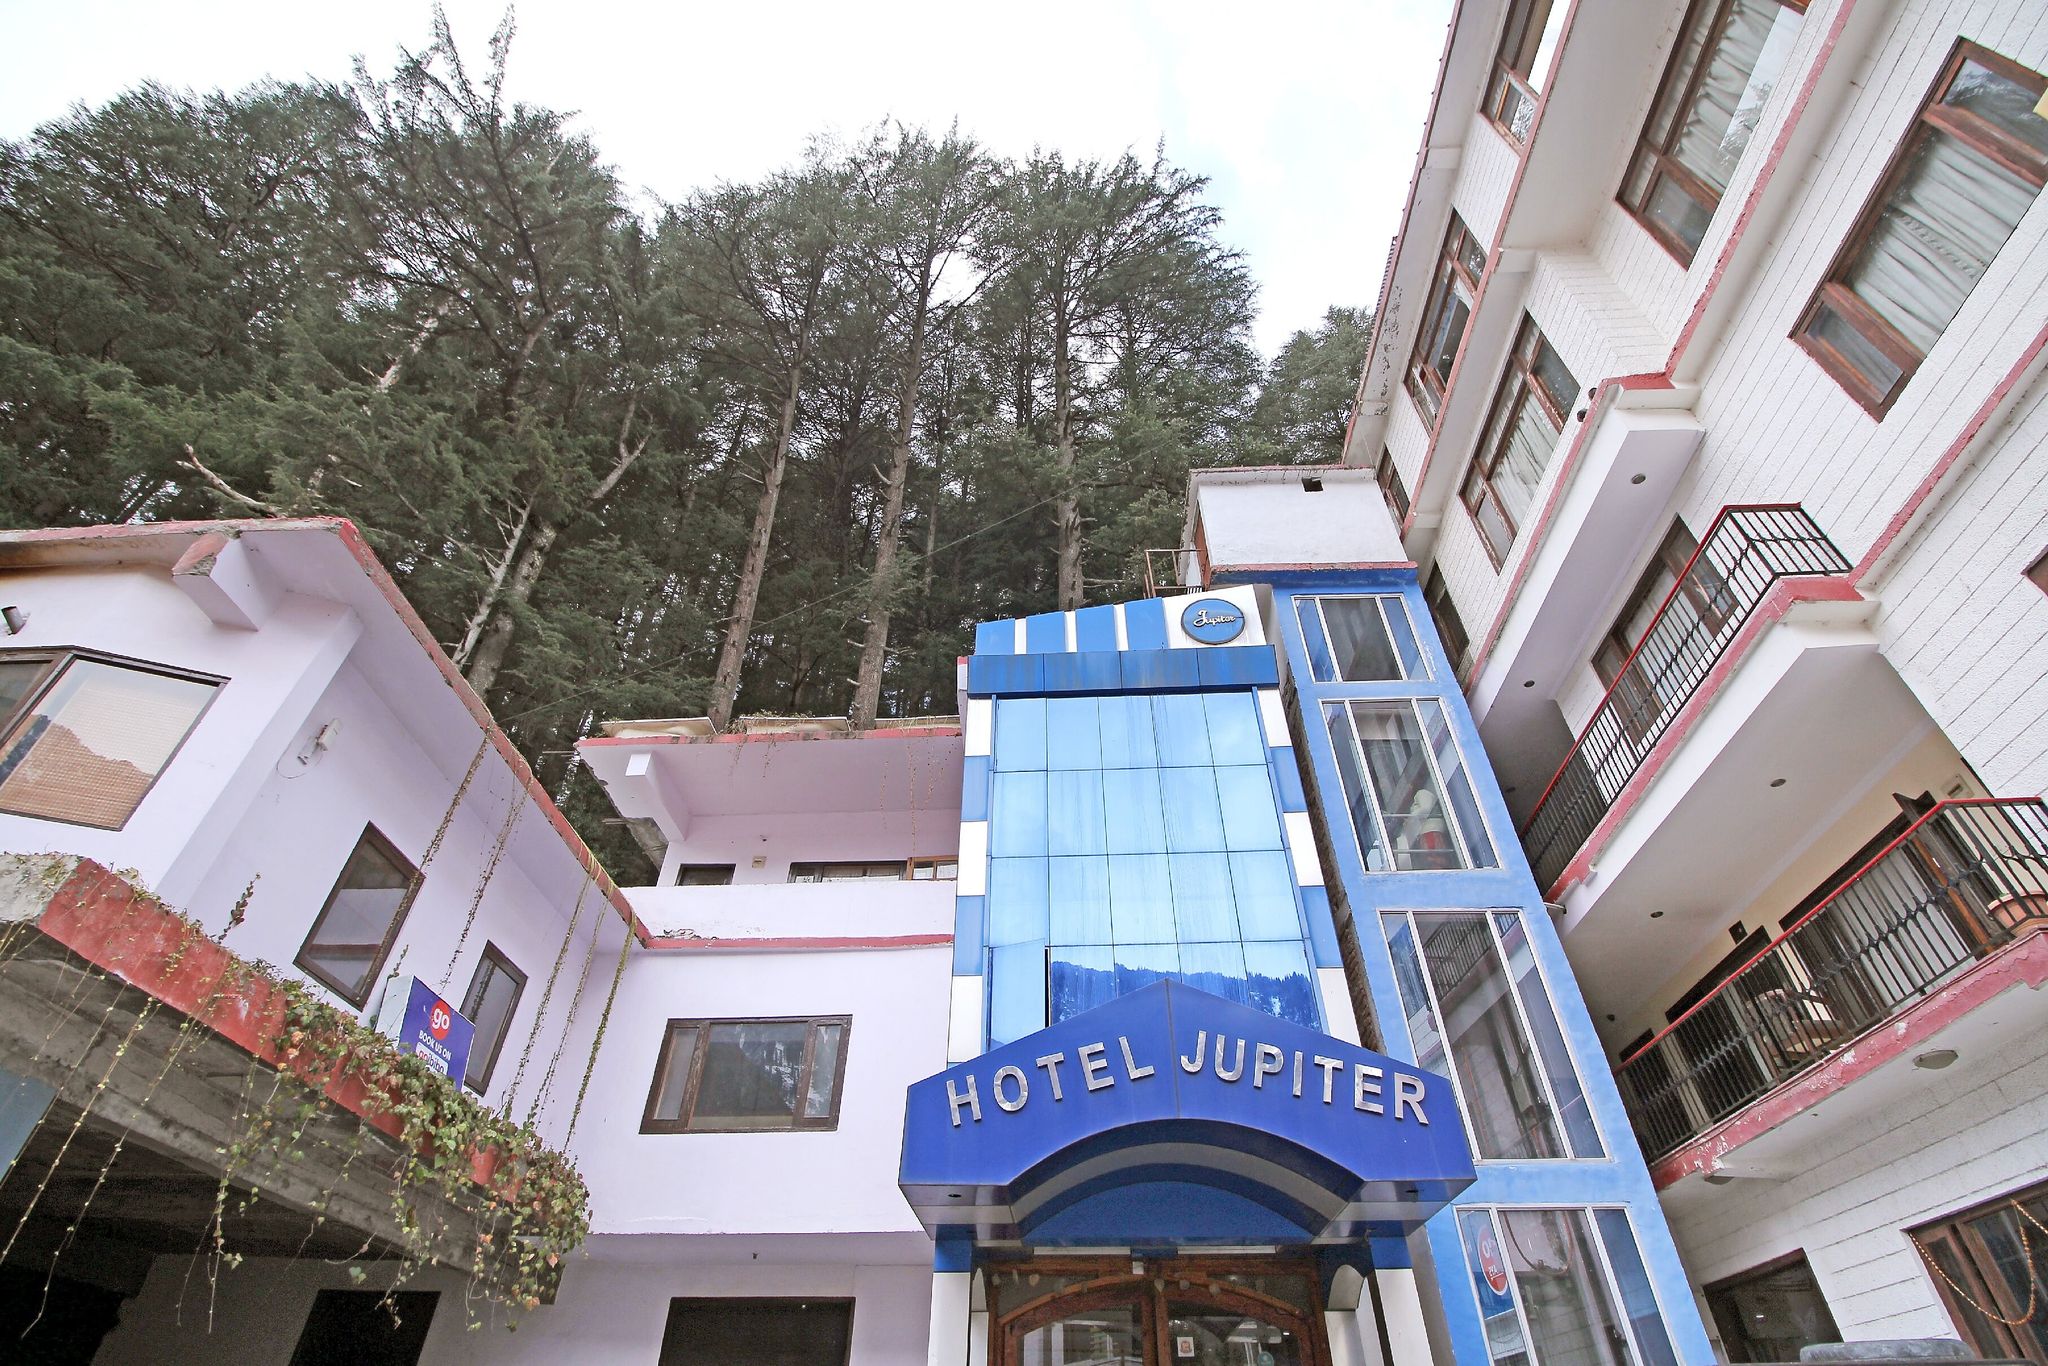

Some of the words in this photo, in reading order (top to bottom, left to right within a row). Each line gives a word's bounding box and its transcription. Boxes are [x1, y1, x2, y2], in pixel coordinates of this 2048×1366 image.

[1193, 609, 1236, 627] Jupiter
[432, 1008, 450, 1029] go
[418, 1030, 435, 1048] BOOK
[435, 1043, 442, 1055] US
[443, 1049, 452, 1061] ON
[946, 1036, 1156, 1128] HOTEL
[1180, 1030, 1430, 1125] JUPITER
